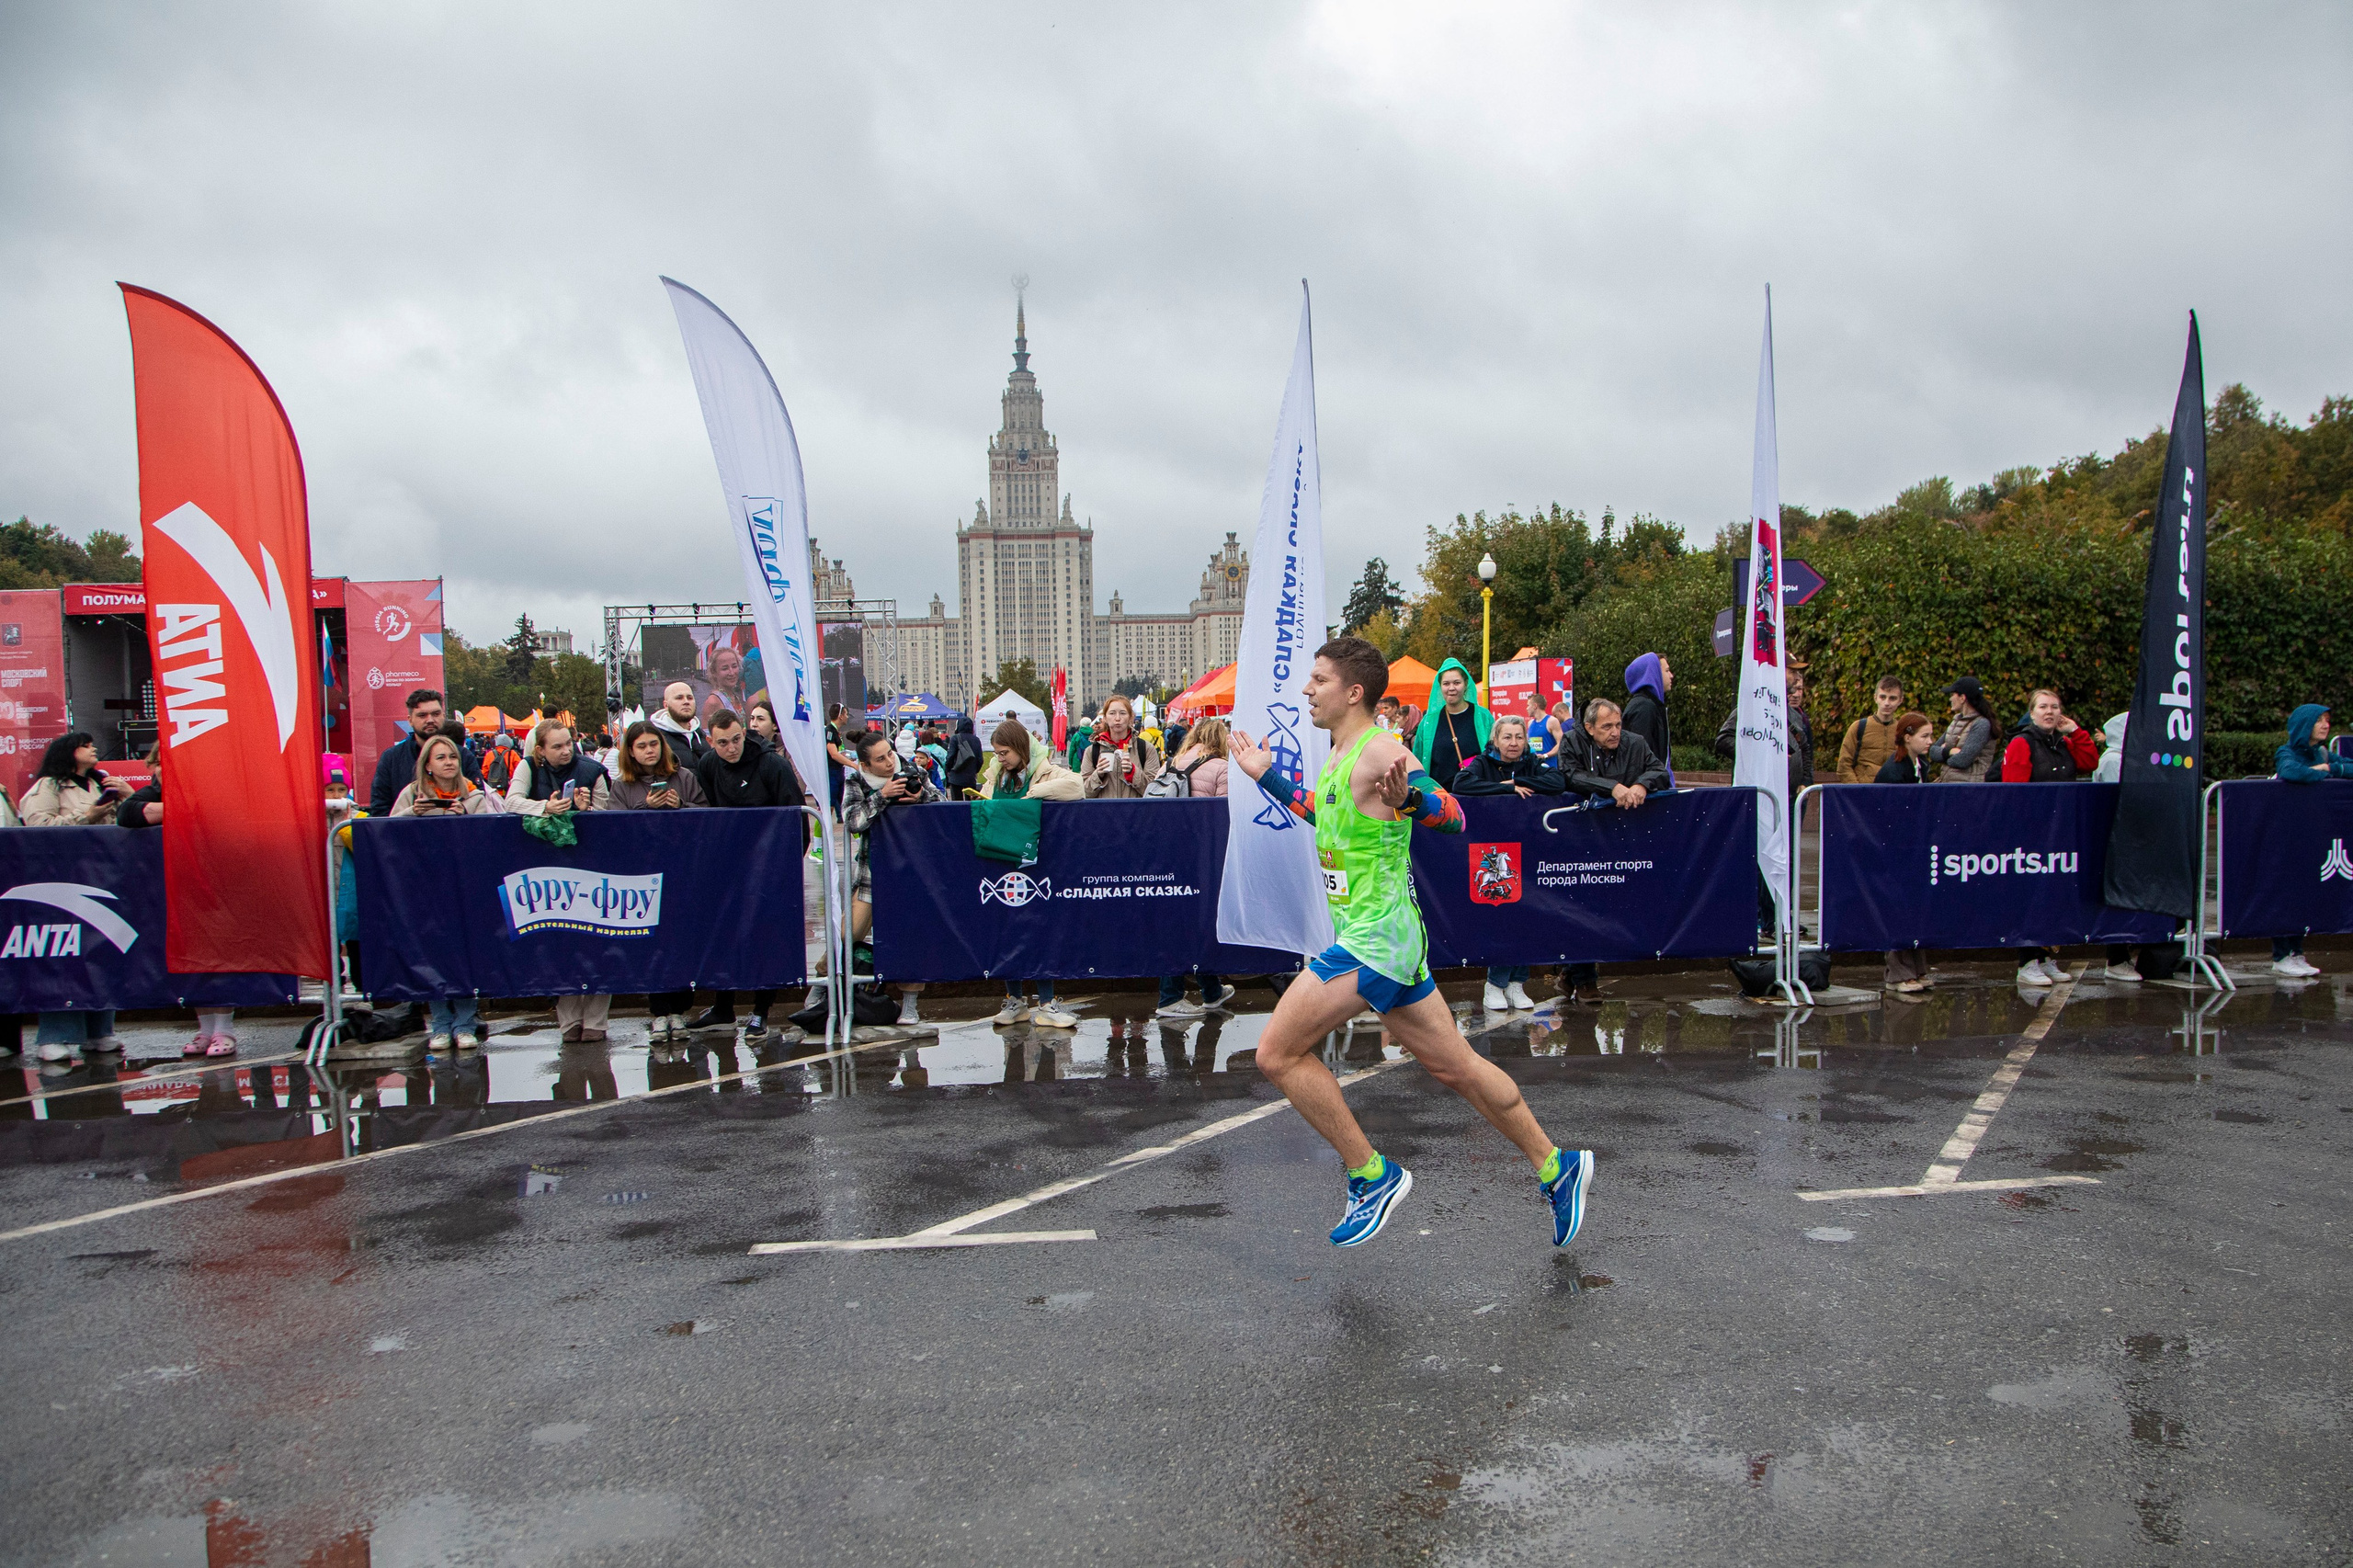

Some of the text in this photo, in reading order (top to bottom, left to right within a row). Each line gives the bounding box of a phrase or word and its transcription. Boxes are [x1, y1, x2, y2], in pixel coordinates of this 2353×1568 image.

[83, 594, 146, 606] ПОЛУМА
[382, 605, 410, 619] RUNNING
[385, 670, 420, 679] pharmeco
[2, 678, 23, 687] СПОРТ
[1537, 860, 1653, 874] Департамент спорта
[1943, 846, 2078, 882] sports.ru
[1082, 872, 1175, 885] группа компаний
[1322, 872, 1337, 891] 05
[1537, 873, 1625, 887] города Москвы
[515, 873, 658, 919] фру-фру
[1055, 884, 1200, 900] «СЛАДКАЯ СКАЗКА»
[517, 921, 650, 937] жевательный мармелад
[0, 923, 81, 958] ANTA
